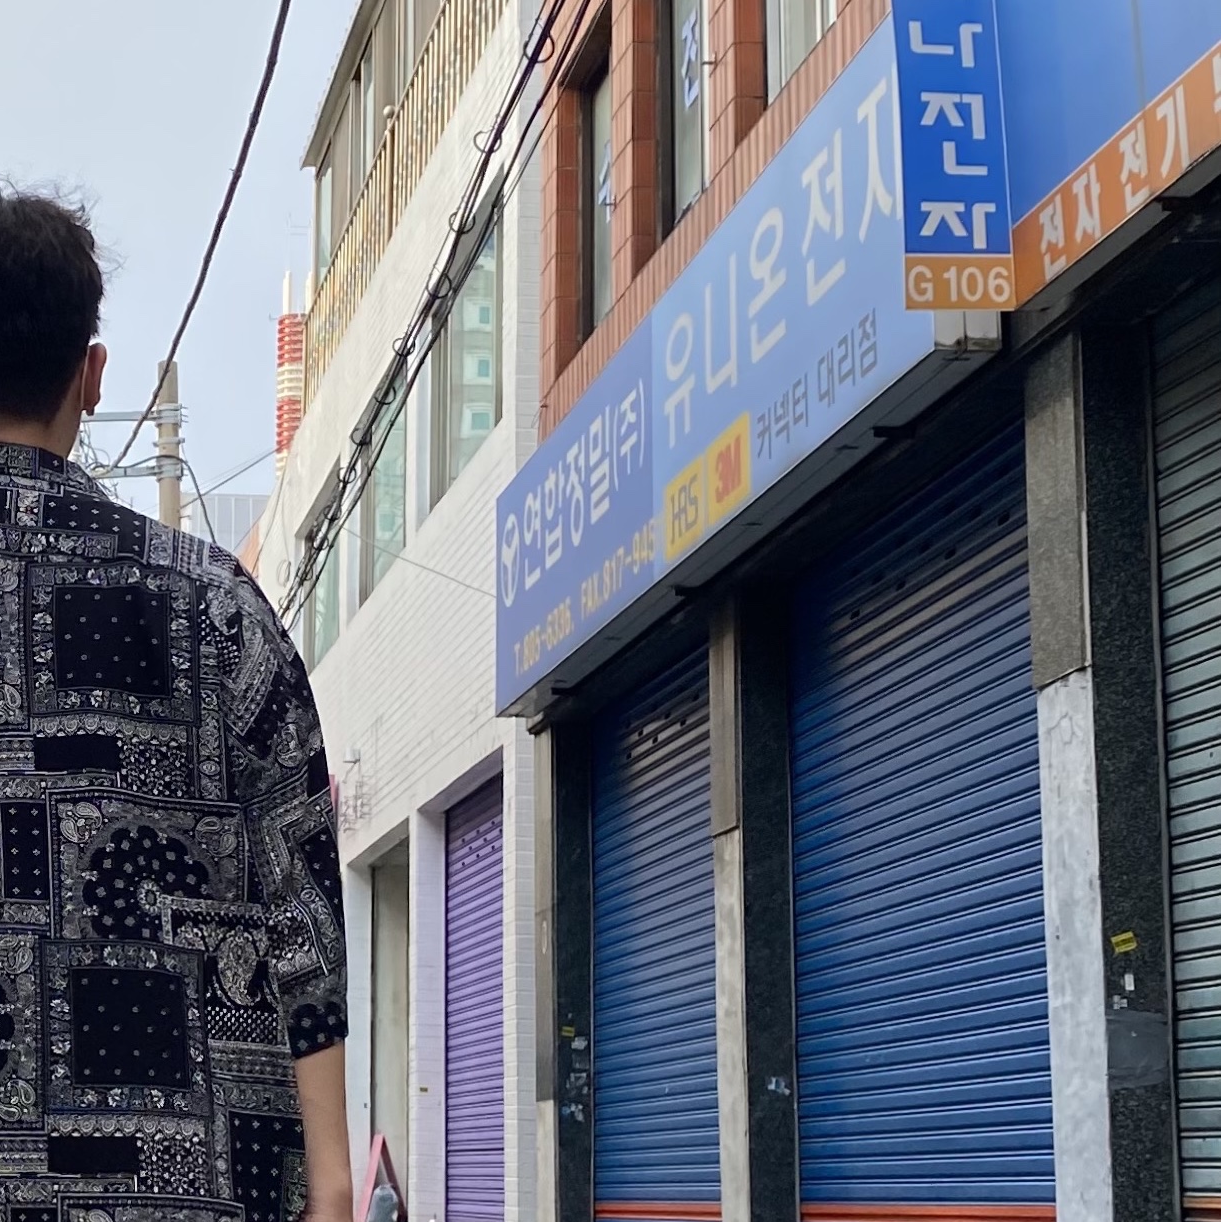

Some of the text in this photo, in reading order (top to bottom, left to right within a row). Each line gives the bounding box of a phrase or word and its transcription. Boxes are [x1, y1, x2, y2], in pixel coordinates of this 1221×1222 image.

[1039, 162, 1101, 283] 전자
[1119, 84, 1191, 213] 전기
[715, 434, 742, 503] 3M
[757, 307, 878, 460] 커넥터 대리점
[523, 378, 645, 591] 연합정밀(주)
